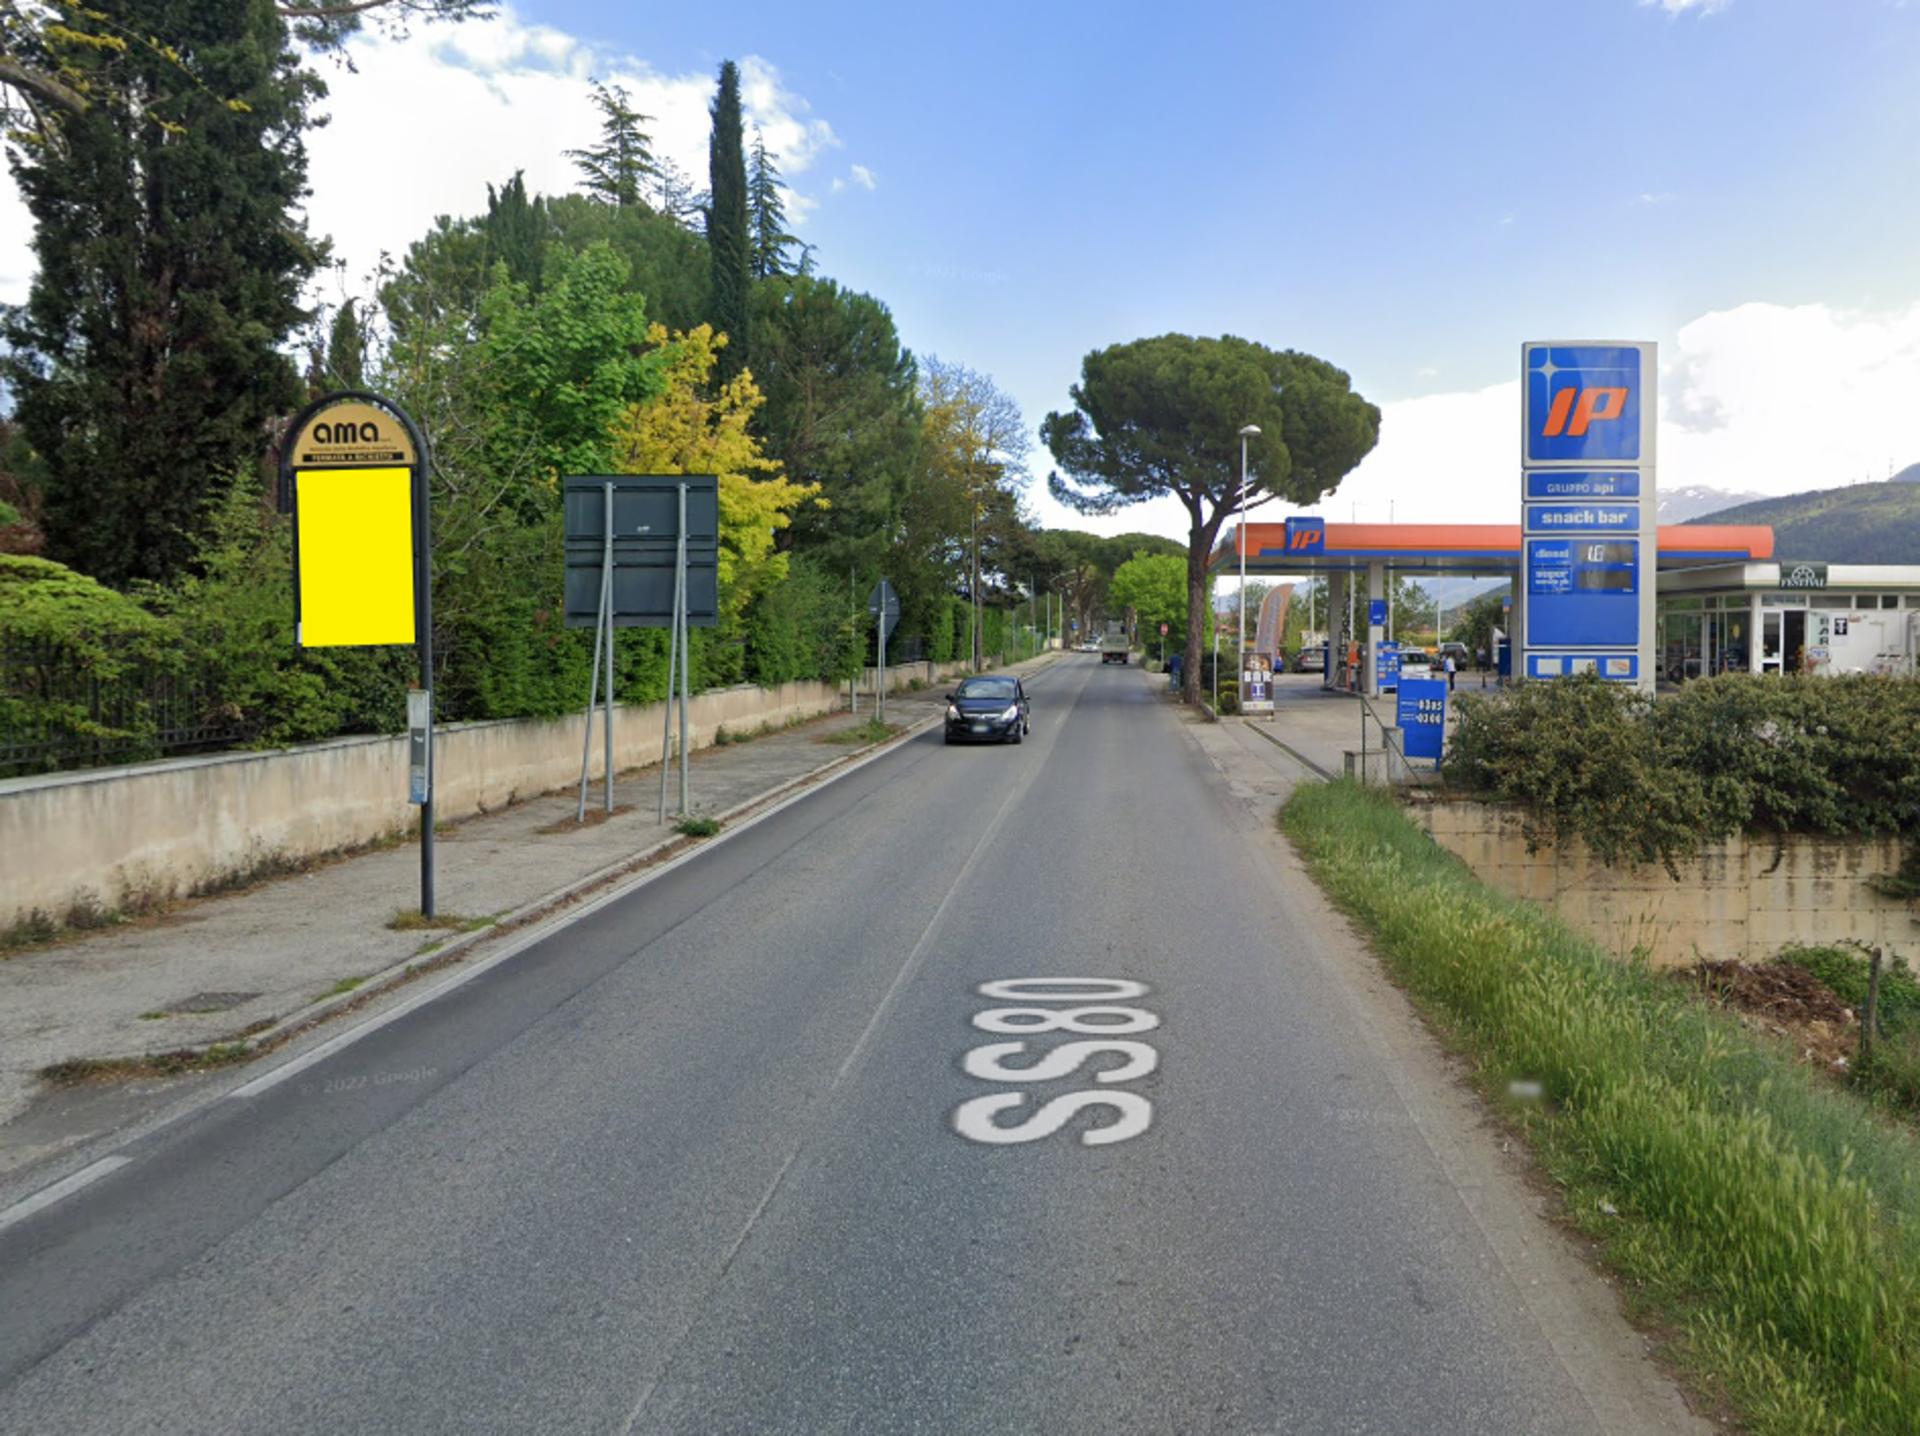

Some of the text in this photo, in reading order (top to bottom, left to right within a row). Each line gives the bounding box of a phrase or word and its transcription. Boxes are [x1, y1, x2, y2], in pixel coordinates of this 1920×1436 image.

[1542, 387, 1630, 437] IP
[313, 422, 379, 444] ama
[1547, 477, 1614, 496] GRUPPO api
[1542, 510, 1629, 524] snack bar
[1290, 530, 1321, 549] IP
[955, 977, 1160, 1146] SS80
